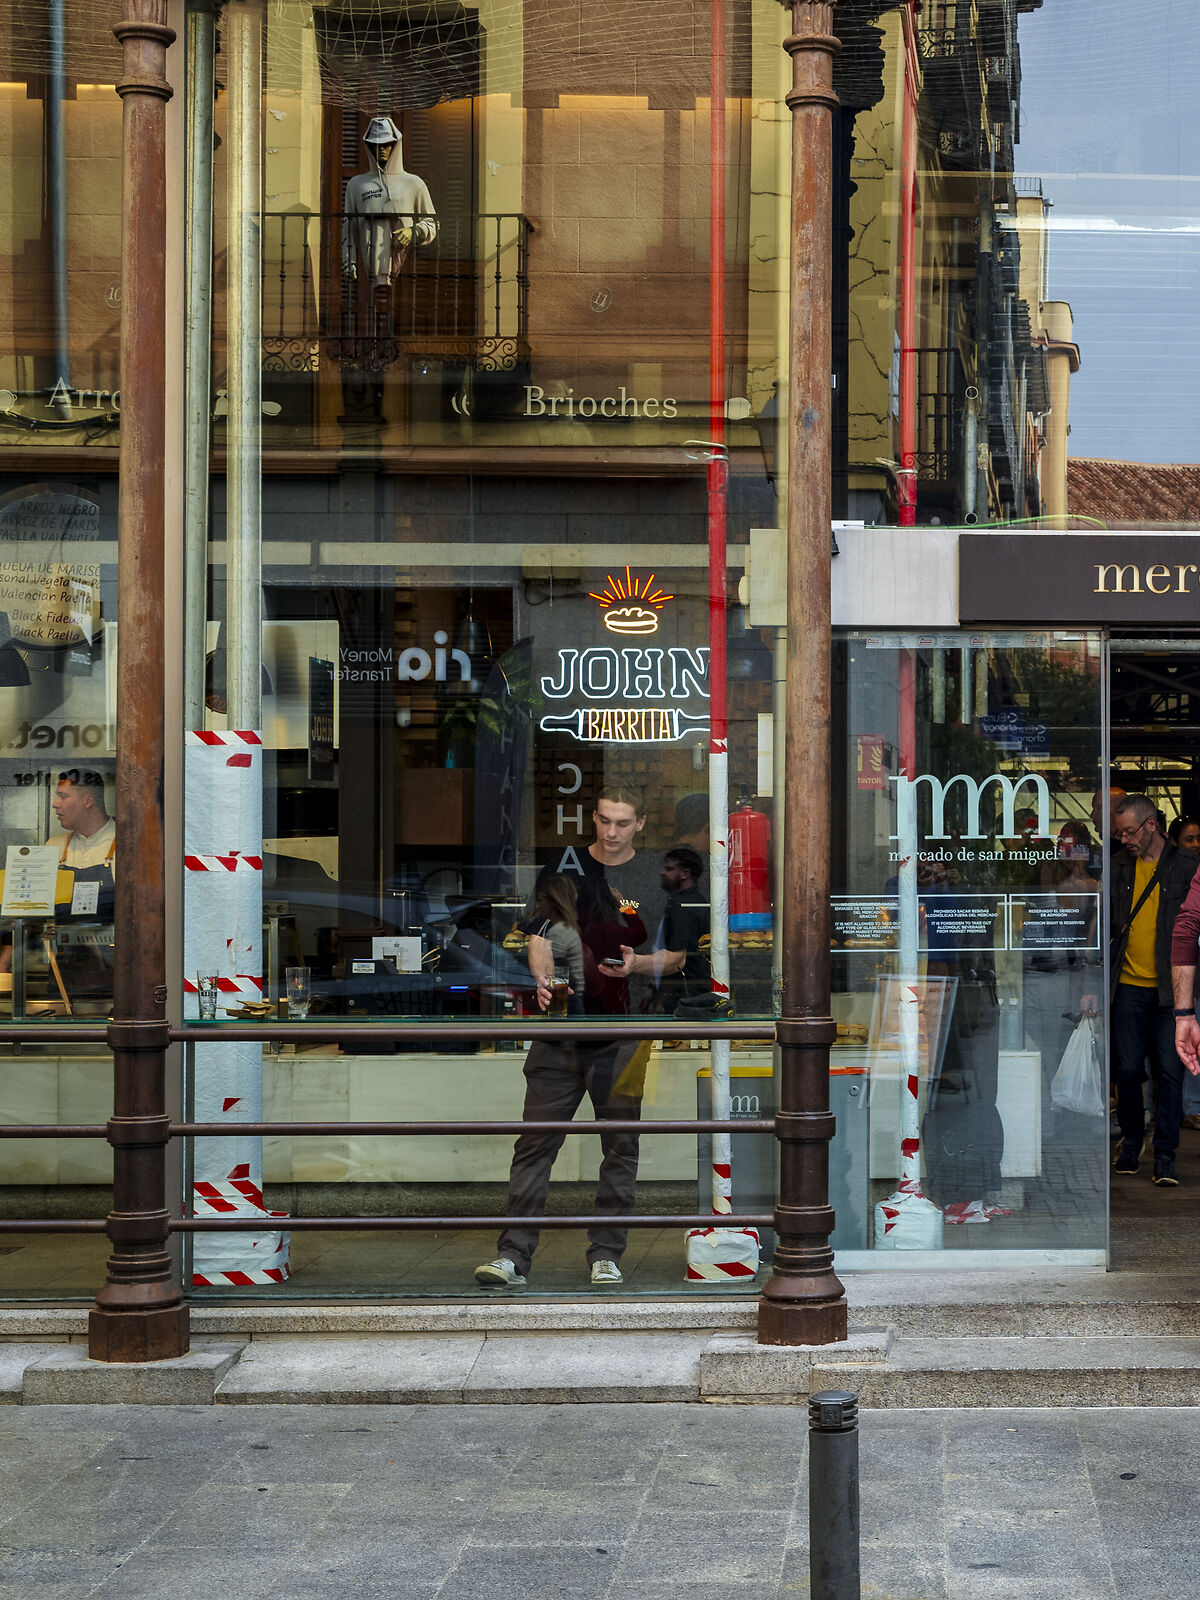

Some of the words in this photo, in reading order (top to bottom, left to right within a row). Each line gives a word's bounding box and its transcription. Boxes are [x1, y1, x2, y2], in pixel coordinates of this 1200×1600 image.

[523, 385, 678, 418] Brioches
[18, 501, 55, 514] ARROZ
[58, 503, 97, 516] NEGRO
[1, 515, 39, 528] ARROZ
[41, 517, 56, 528] DE
[61, 518, 101, 531] MARIS
[1, 587, 56, 601] Valencian
[60, 591, 92, 604] Paella
[12, 608, 42, 622] Black
[14, 625, 44, 639] Black
[47, 628, 80, 641] Paella
[541, 648, 711, 698] JOHN
[588, 707, 671, 741] BARRITA
[889, 847, 953, 861] mcado
[957, 847, 975, 861] de
[978, 851, 1004, 861] san
[1008, 847, 1059, 866] miguel
[620, 900, 640, 909] VANS
